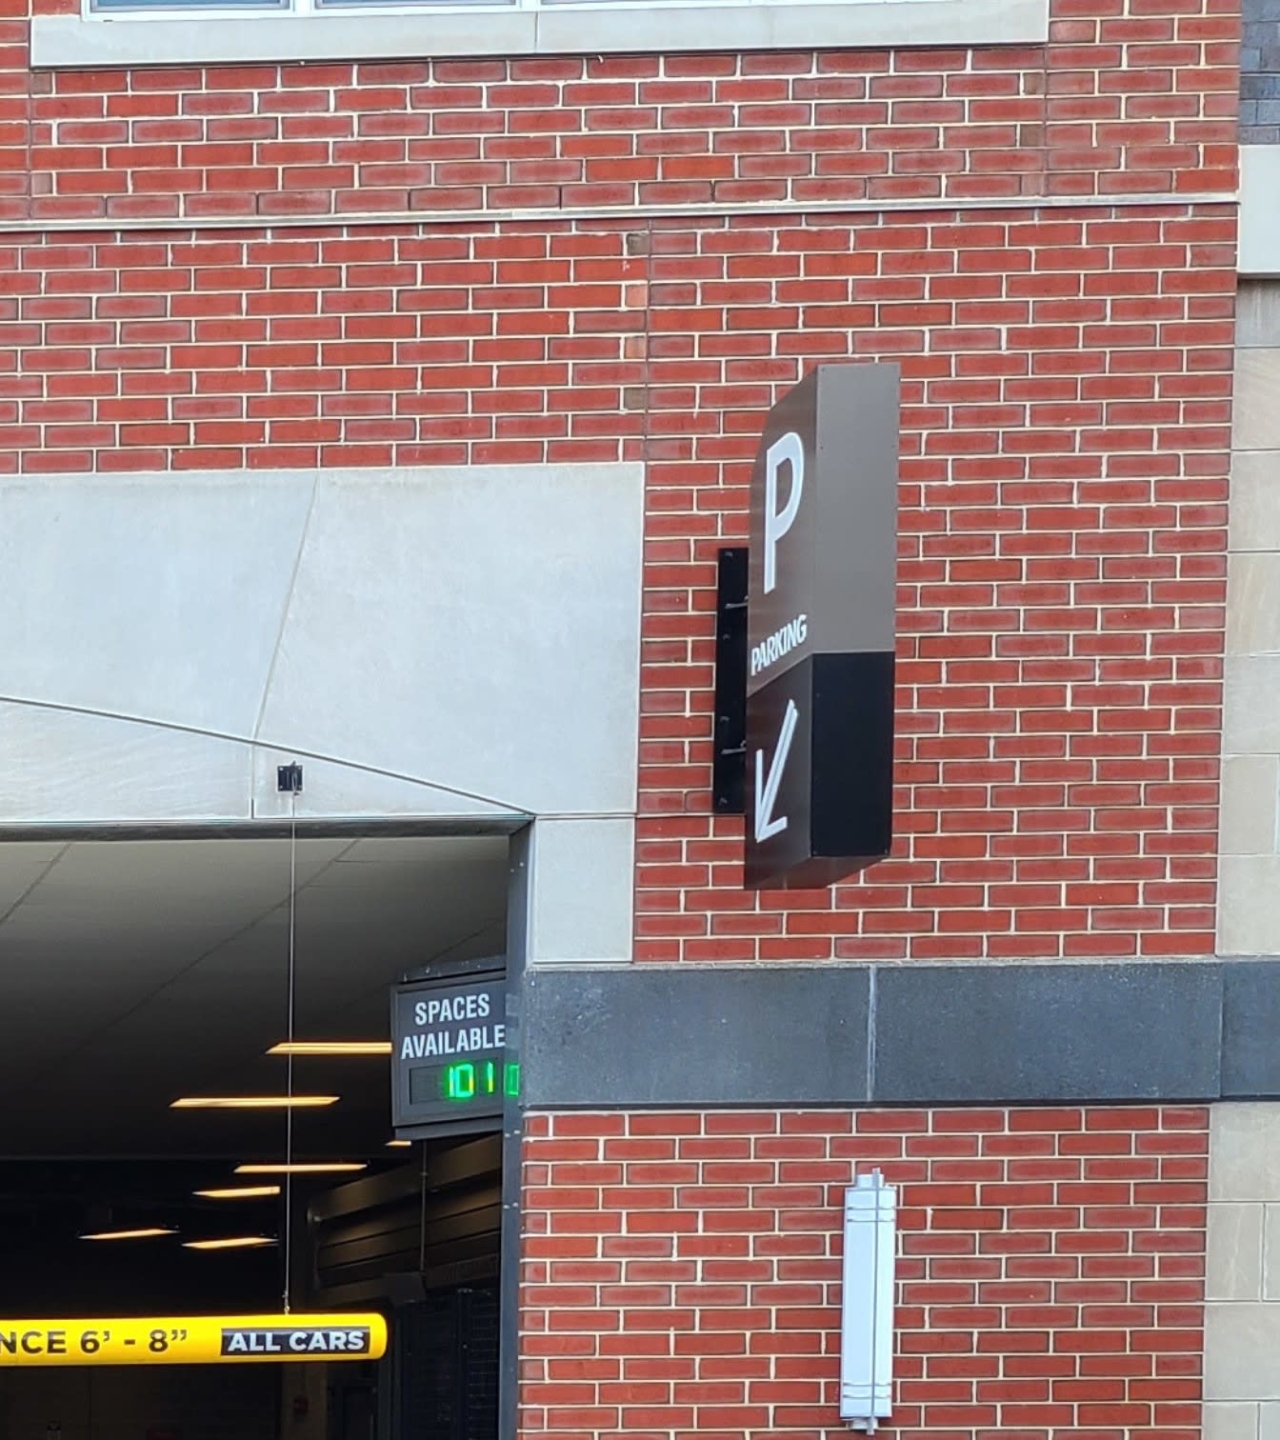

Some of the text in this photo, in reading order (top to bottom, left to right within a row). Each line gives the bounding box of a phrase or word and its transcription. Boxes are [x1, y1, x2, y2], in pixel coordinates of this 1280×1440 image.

[763, 431, 805, 595] P
[750, 613, 808, 677] PARKING
[414, 993, 491, 1026] SPACES
[400, 1024, 506, 1060] AVAILABLE
[228, 1332, 281, 1352] ALL
[289, 1331, 365, 1351] CARS
